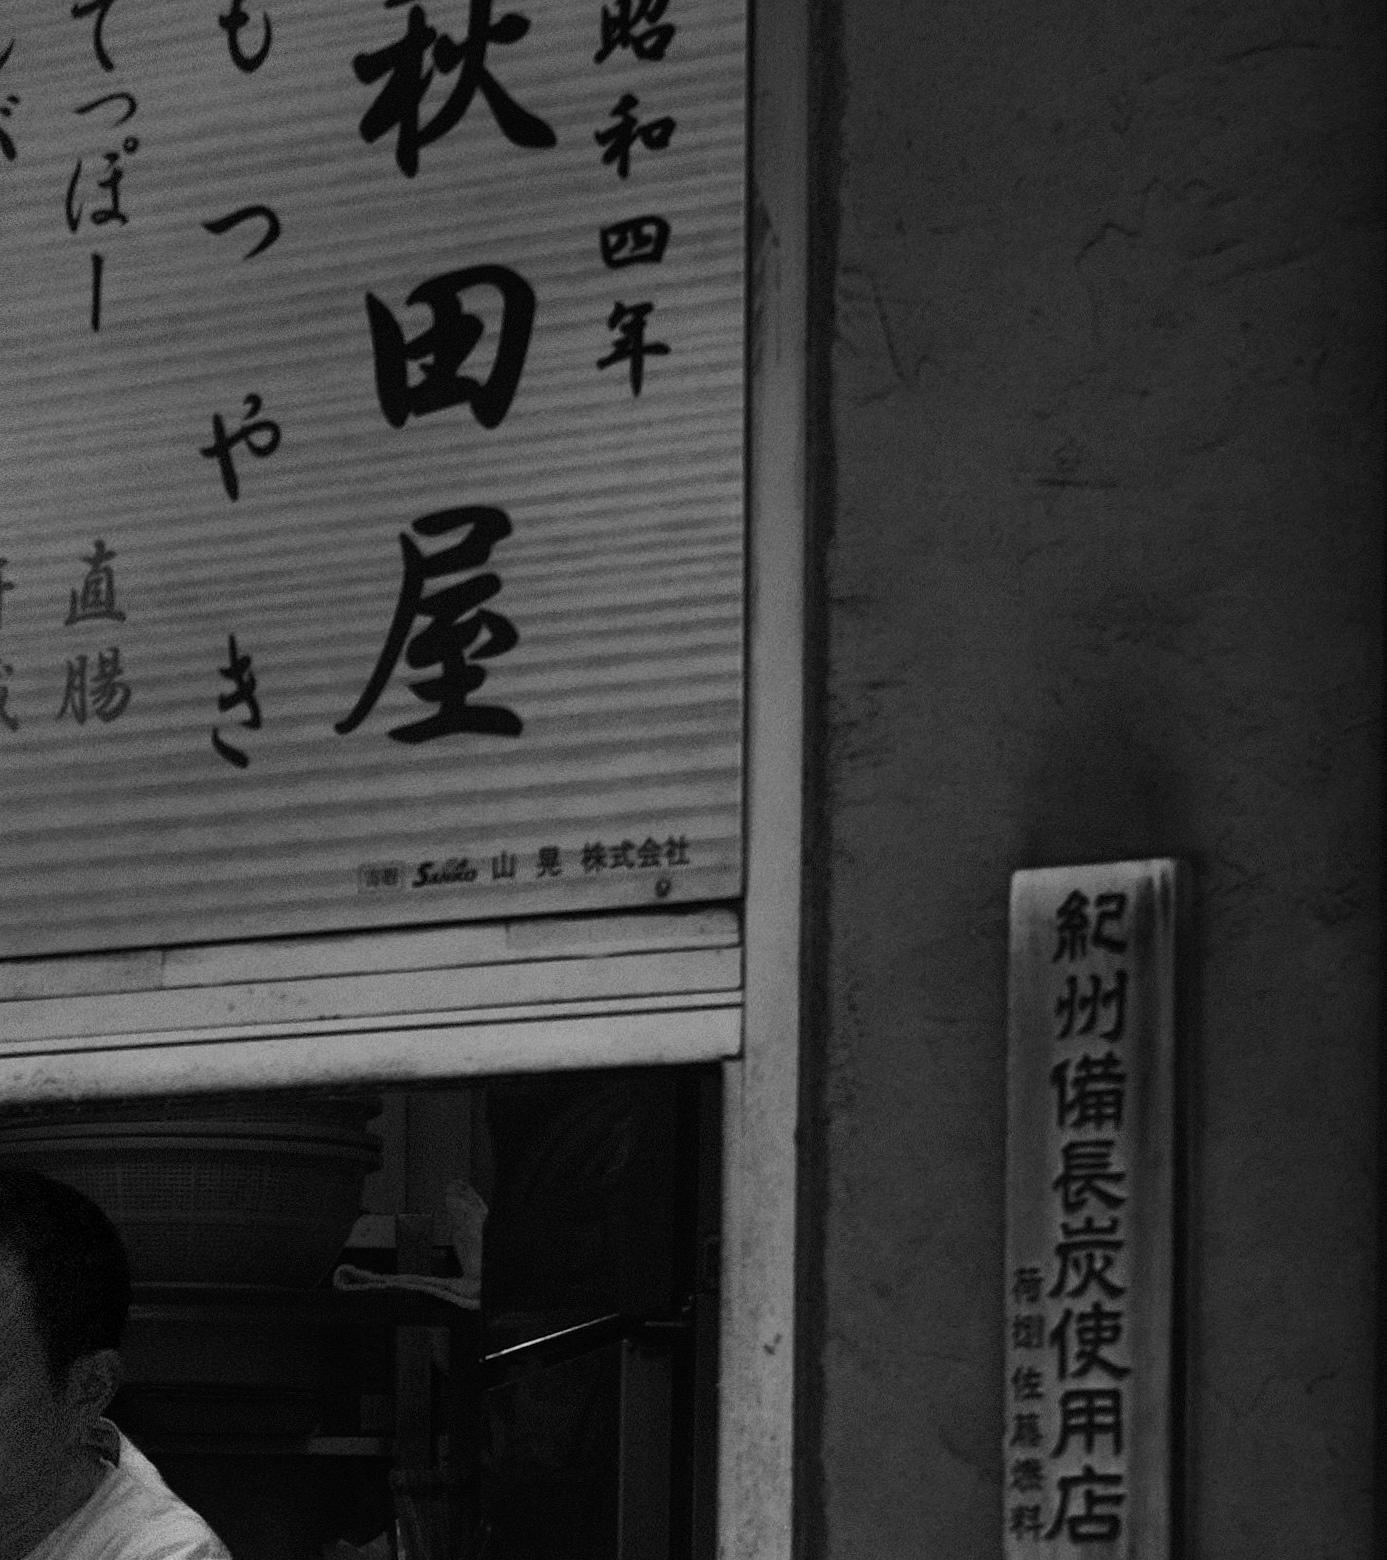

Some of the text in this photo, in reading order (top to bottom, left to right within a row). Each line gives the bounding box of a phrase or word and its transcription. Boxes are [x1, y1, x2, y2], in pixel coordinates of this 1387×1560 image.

[56, 539, 133, 725] 直腸
[581, 834, 690, 871] 株式会社
[1045, 887, 1131, 1545] 紀州備長炭使用店
